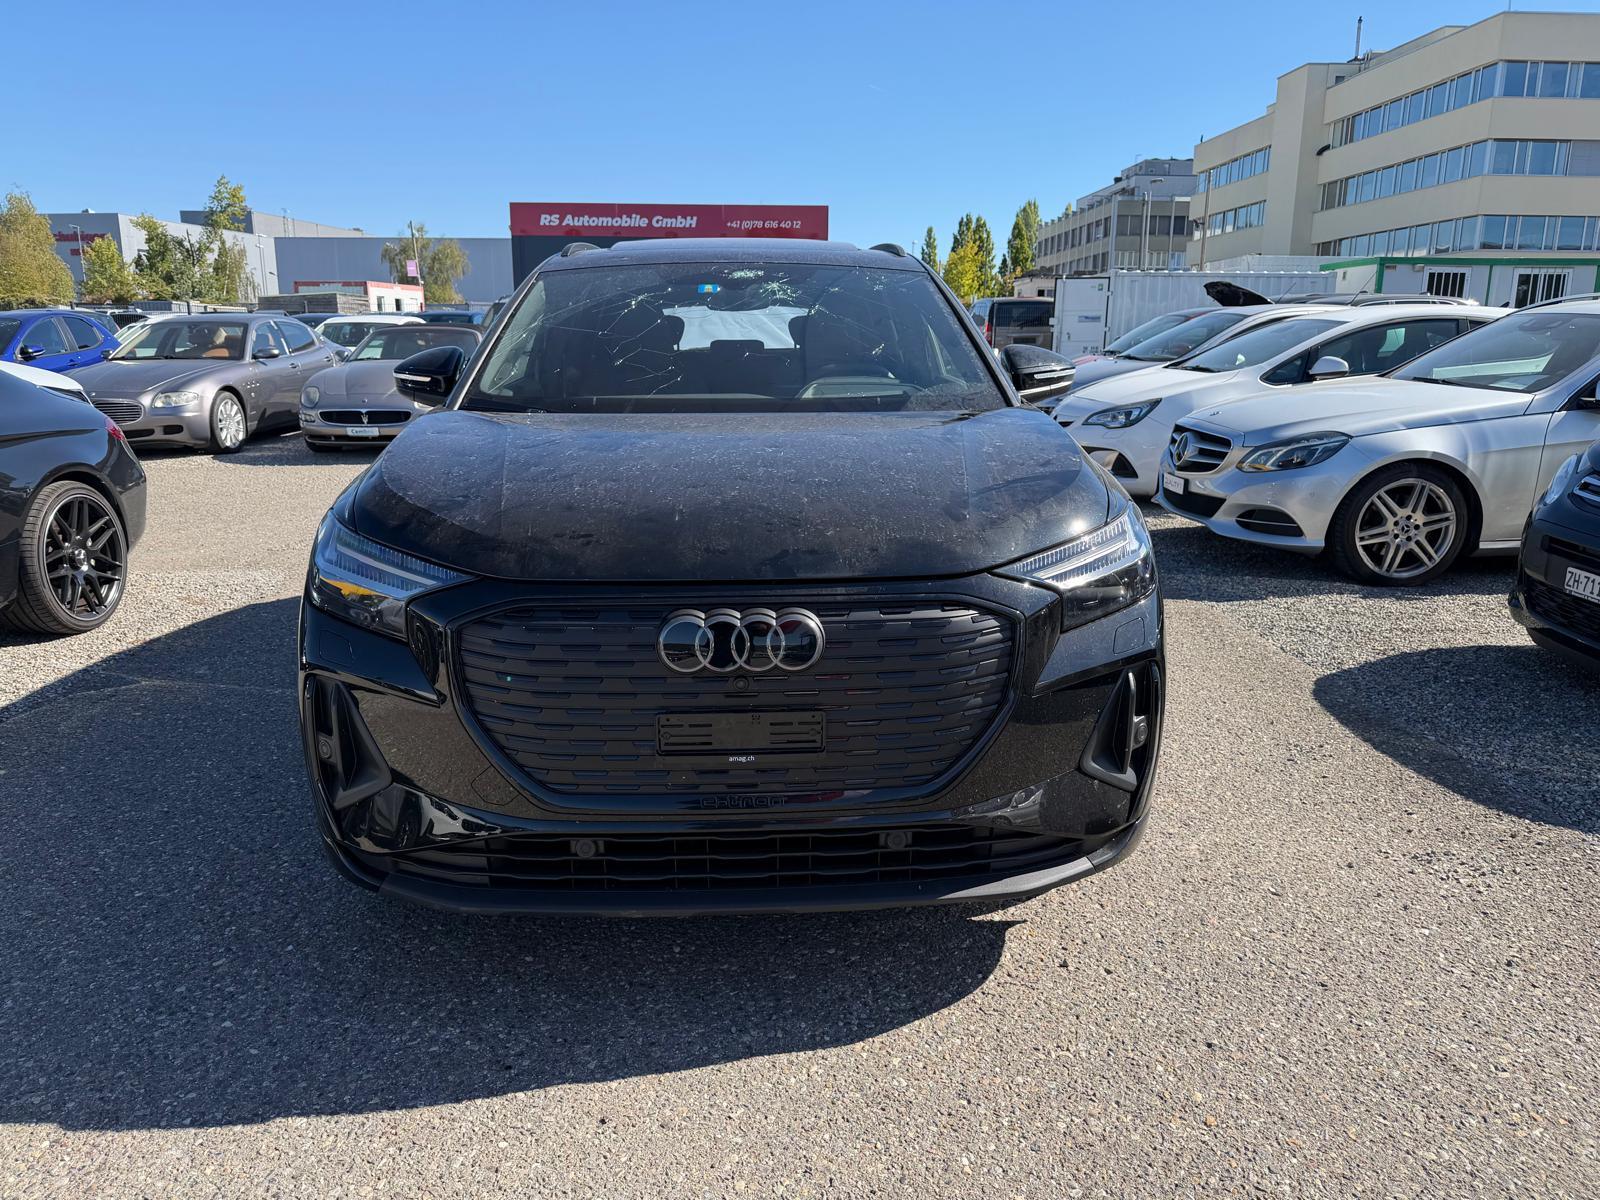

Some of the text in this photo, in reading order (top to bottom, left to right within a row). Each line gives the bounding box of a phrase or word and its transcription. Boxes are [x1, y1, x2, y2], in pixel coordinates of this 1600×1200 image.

[540, 214, 698, 228] RS Automobile GmbH
[726, 220, 801, 230] +41 (0)78 616 40 12
